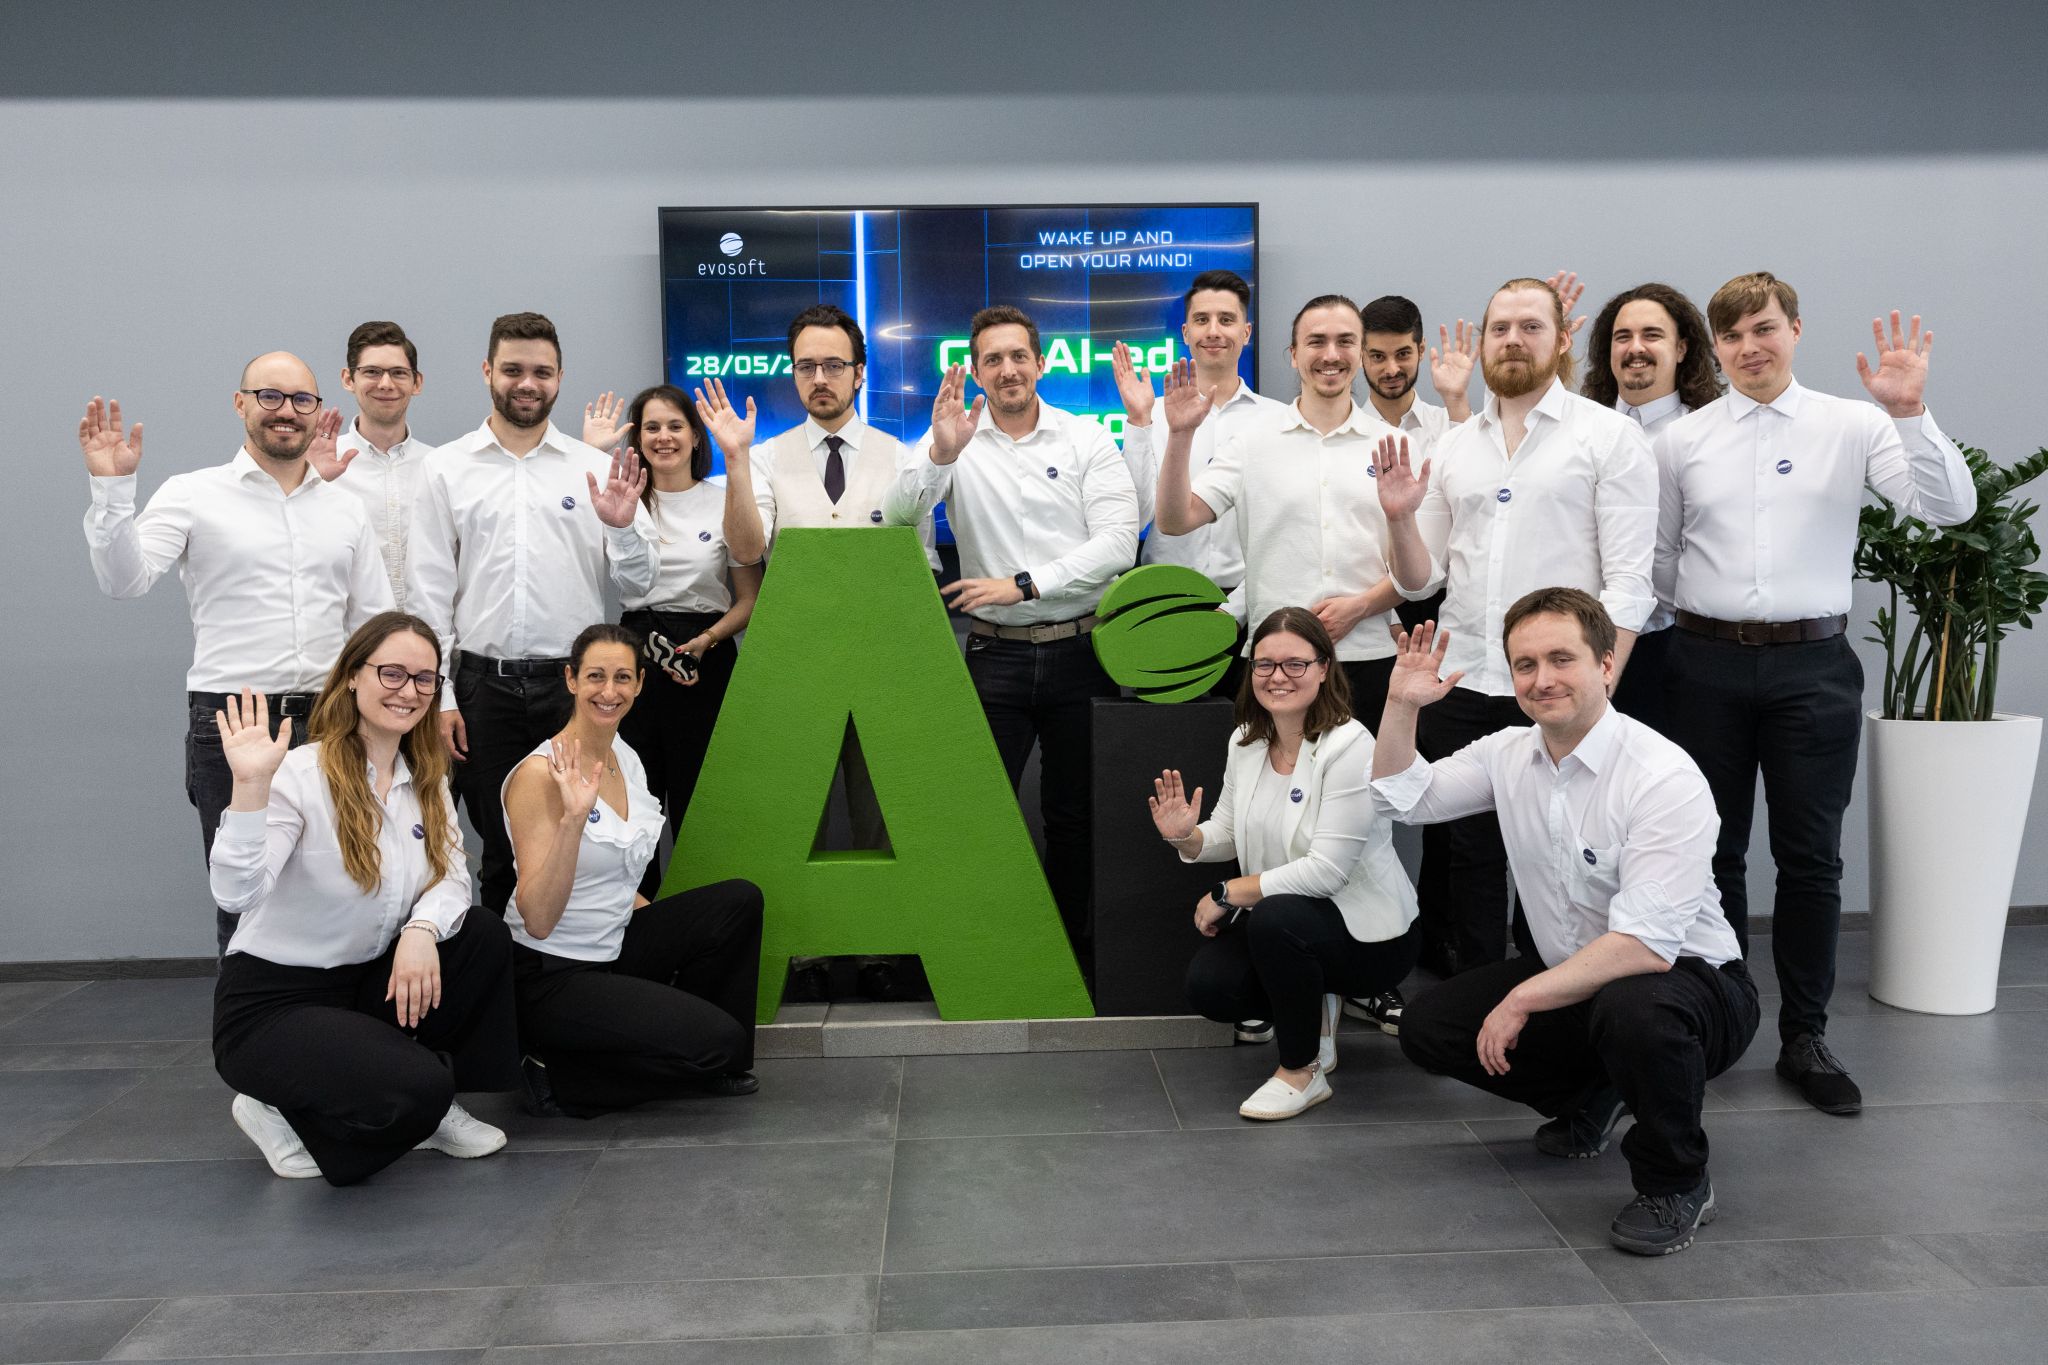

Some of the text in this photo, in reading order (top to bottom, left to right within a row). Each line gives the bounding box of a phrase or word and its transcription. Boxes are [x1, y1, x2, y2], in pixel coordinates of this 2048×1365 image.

[1039, 231, 1173, 246] WAKE UP AND
[697, 258, 767, 276] evosoft
[1020, 253, 1193, 269] OPEN YOUR MIND!
[939, 337, 1174, 374] GAI-ed
[686, 354, 793, 376] 28/05/2
